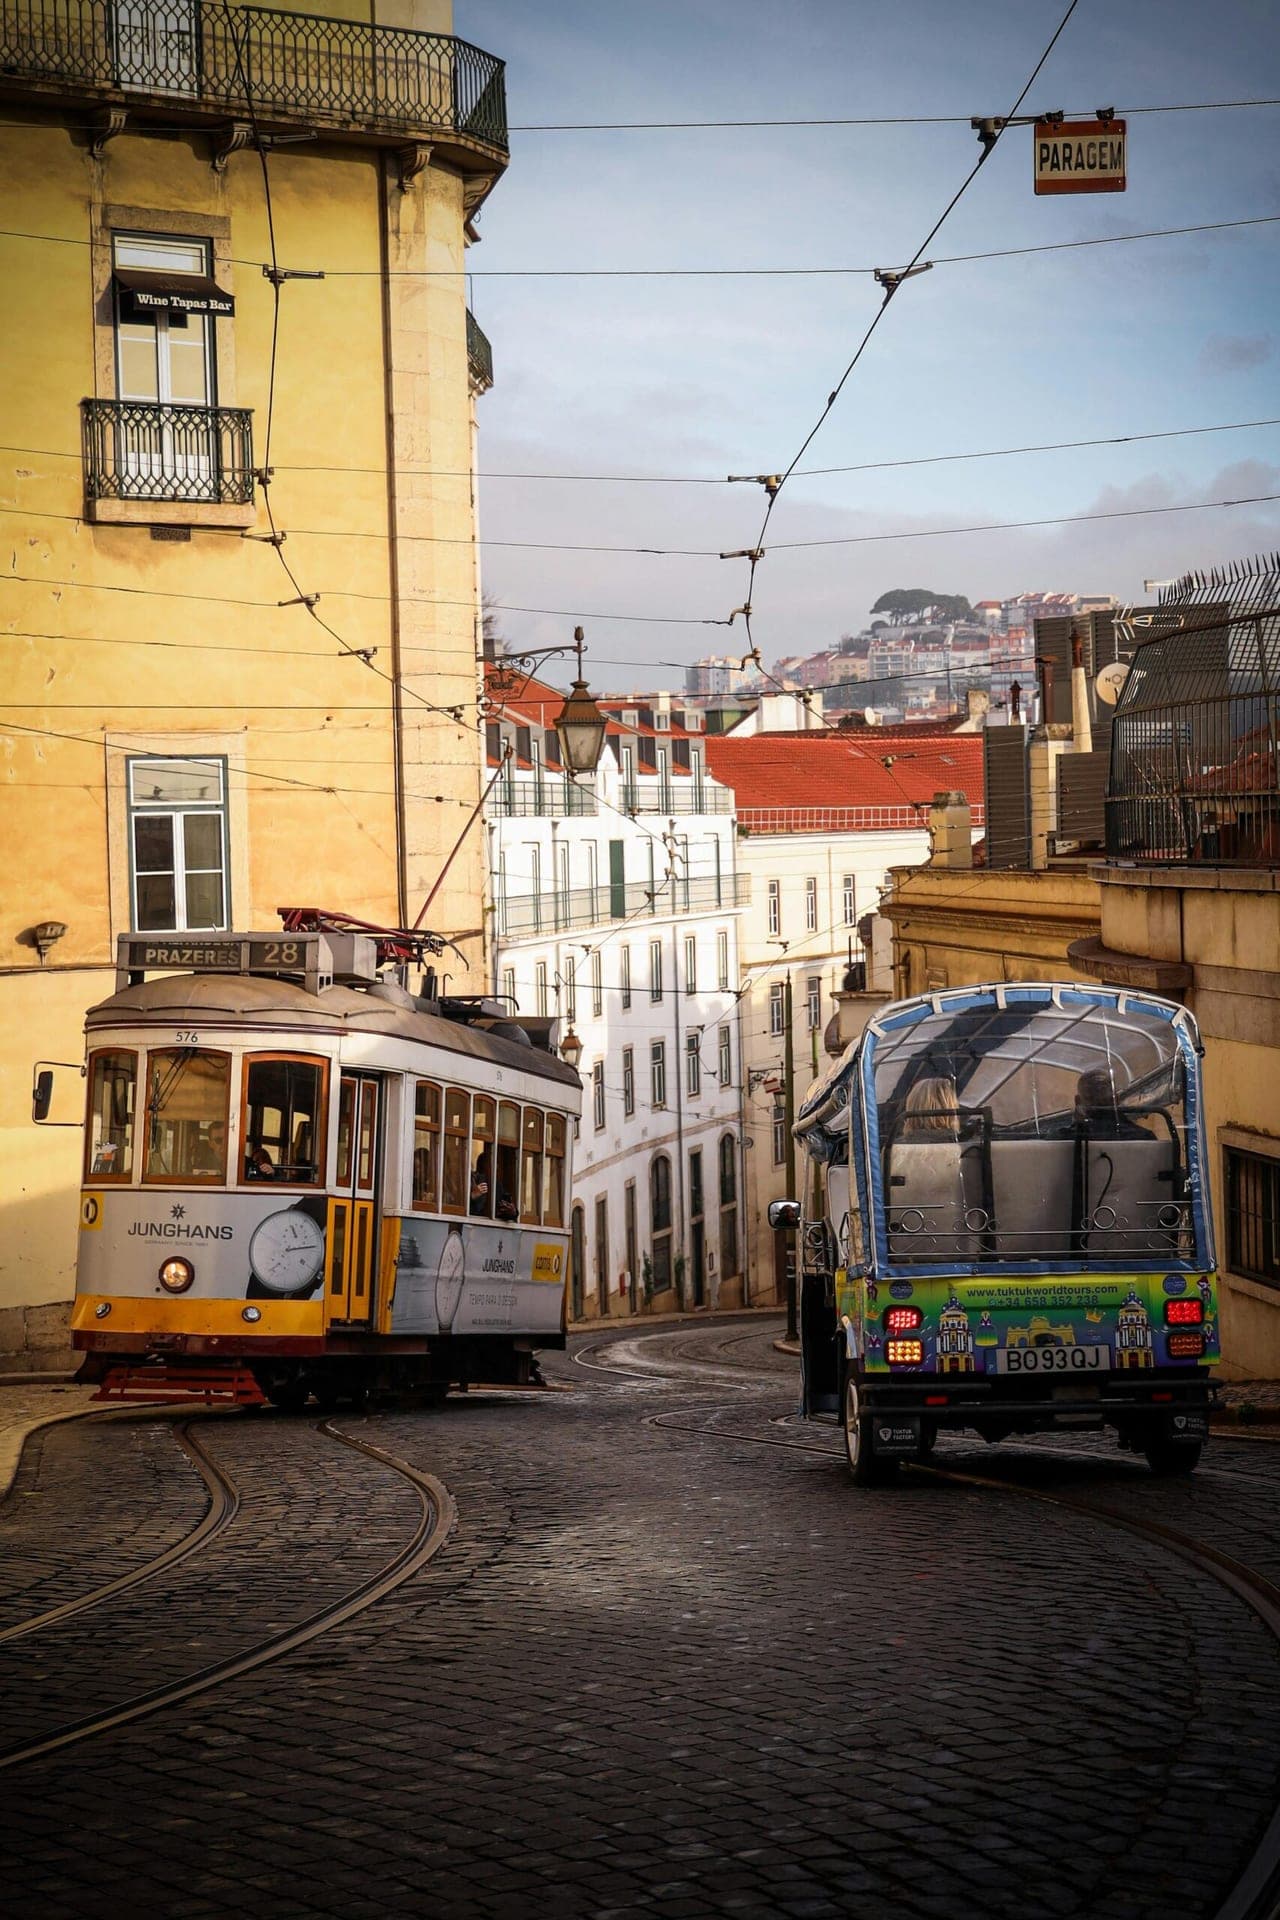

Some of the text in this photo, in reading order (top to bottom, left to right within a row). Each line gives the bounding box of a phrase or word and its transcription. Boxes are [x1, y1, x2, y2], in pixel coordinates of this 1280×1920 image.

[1040, 142, 1121, 171] PARAGEM
[137, 294, 232, 311] Wine Tapas Bar
[146, 948, 239, 965] PRAZERES
[263, 943, 298, 964] 28
[176, 1031, 198, 1043] 576
[128, 1222, 233, 1240] JUNGHANS
[482, 1258, 515, 1274] JUNGHANS
[967, 1285, 1118, 1297] www.tuktukworldtours.com
